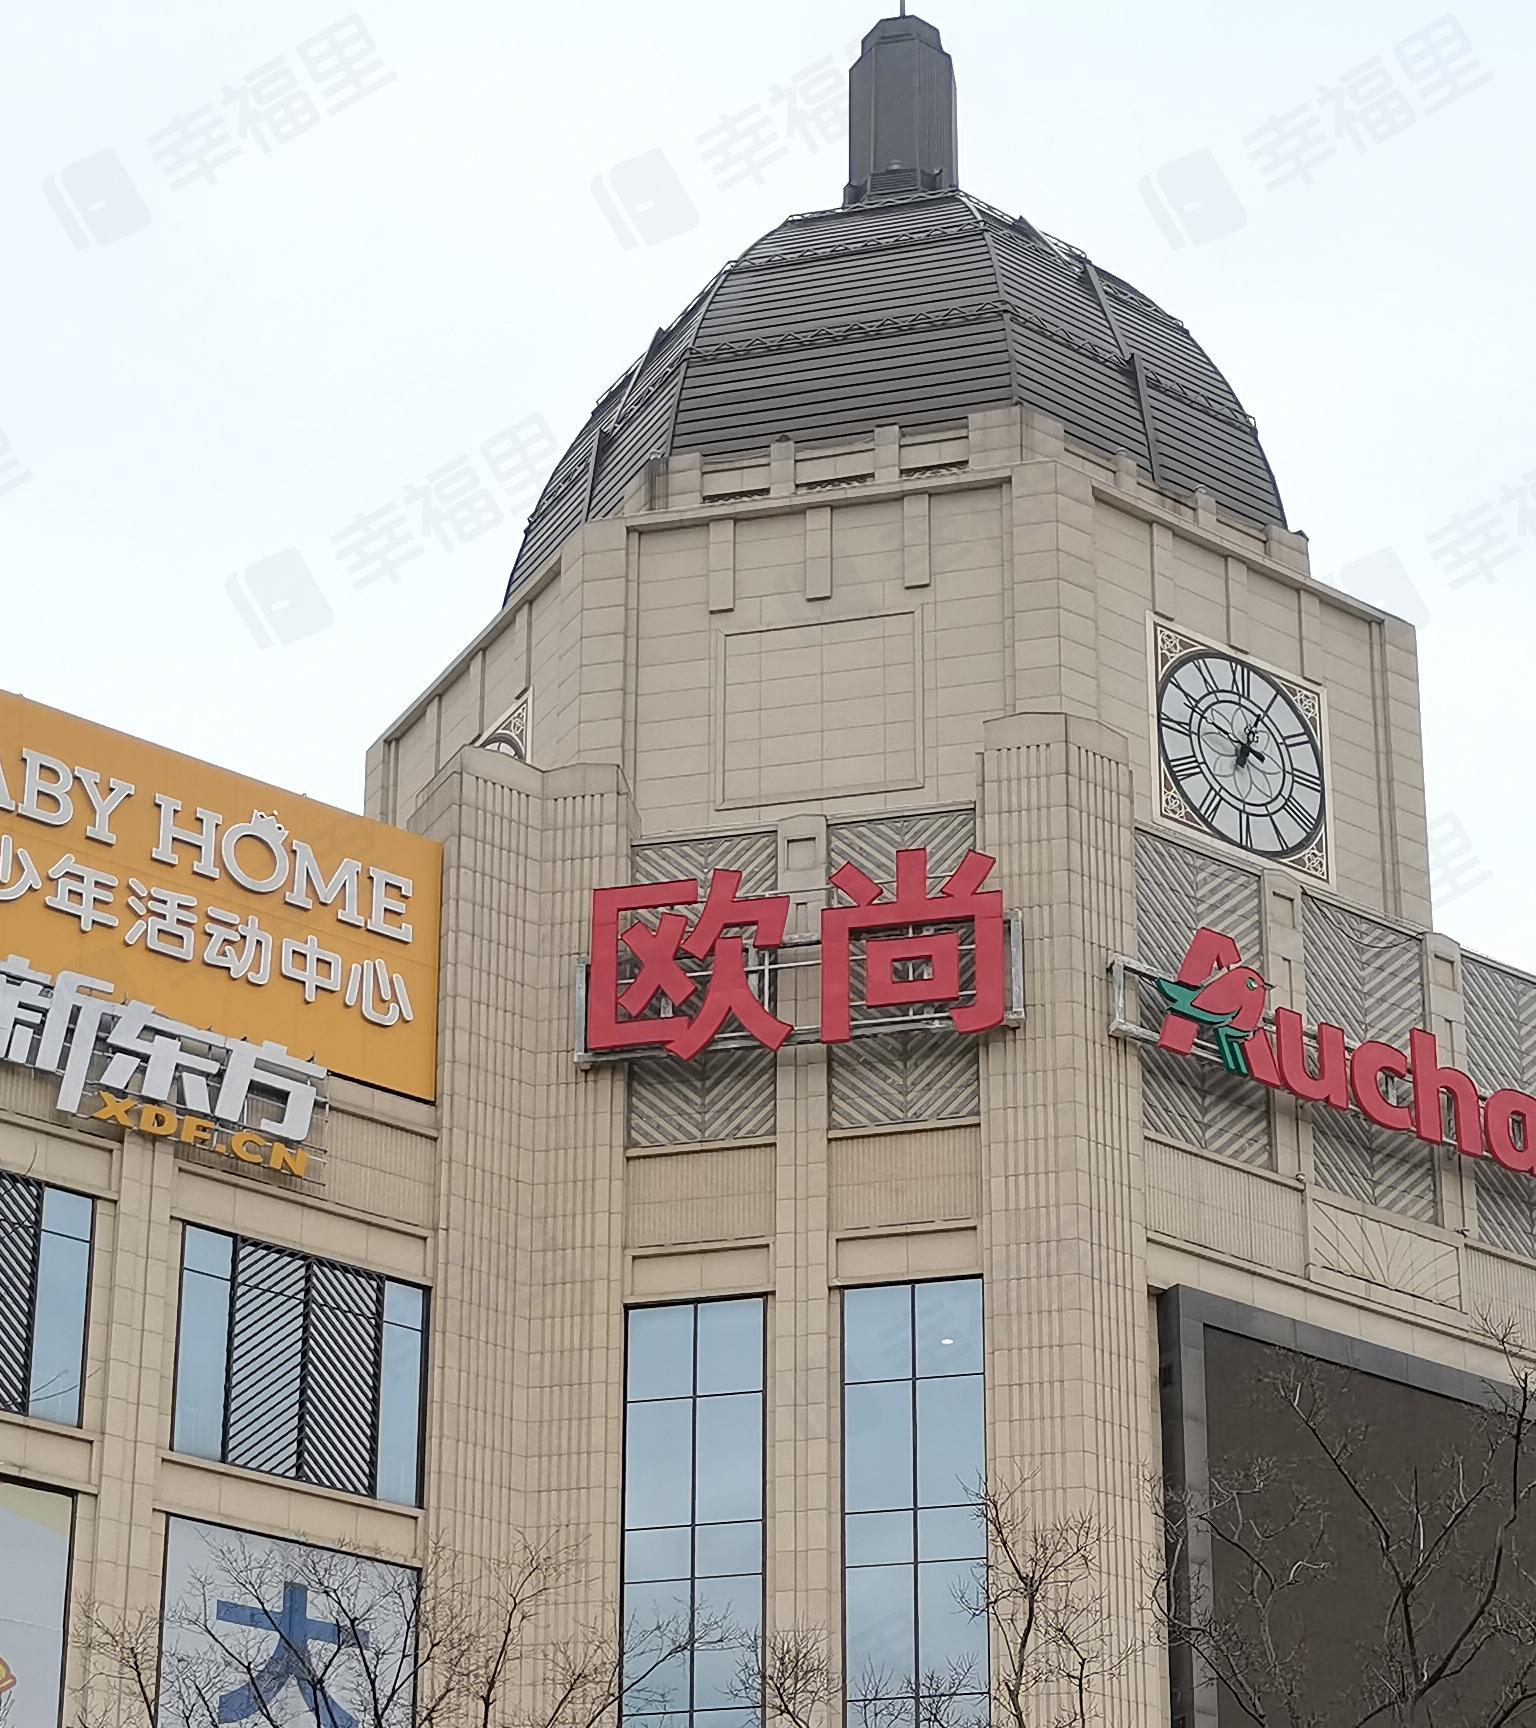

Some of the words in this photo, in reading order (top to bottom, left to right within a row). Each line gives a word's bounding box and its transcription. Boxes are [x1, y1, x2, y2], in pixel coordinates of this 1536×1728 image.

[151, 791, 414, 943] HOME
[584, 846, 1007, 1062] 欧尚
[95, 1091, 309, 1179] XDF.CN
